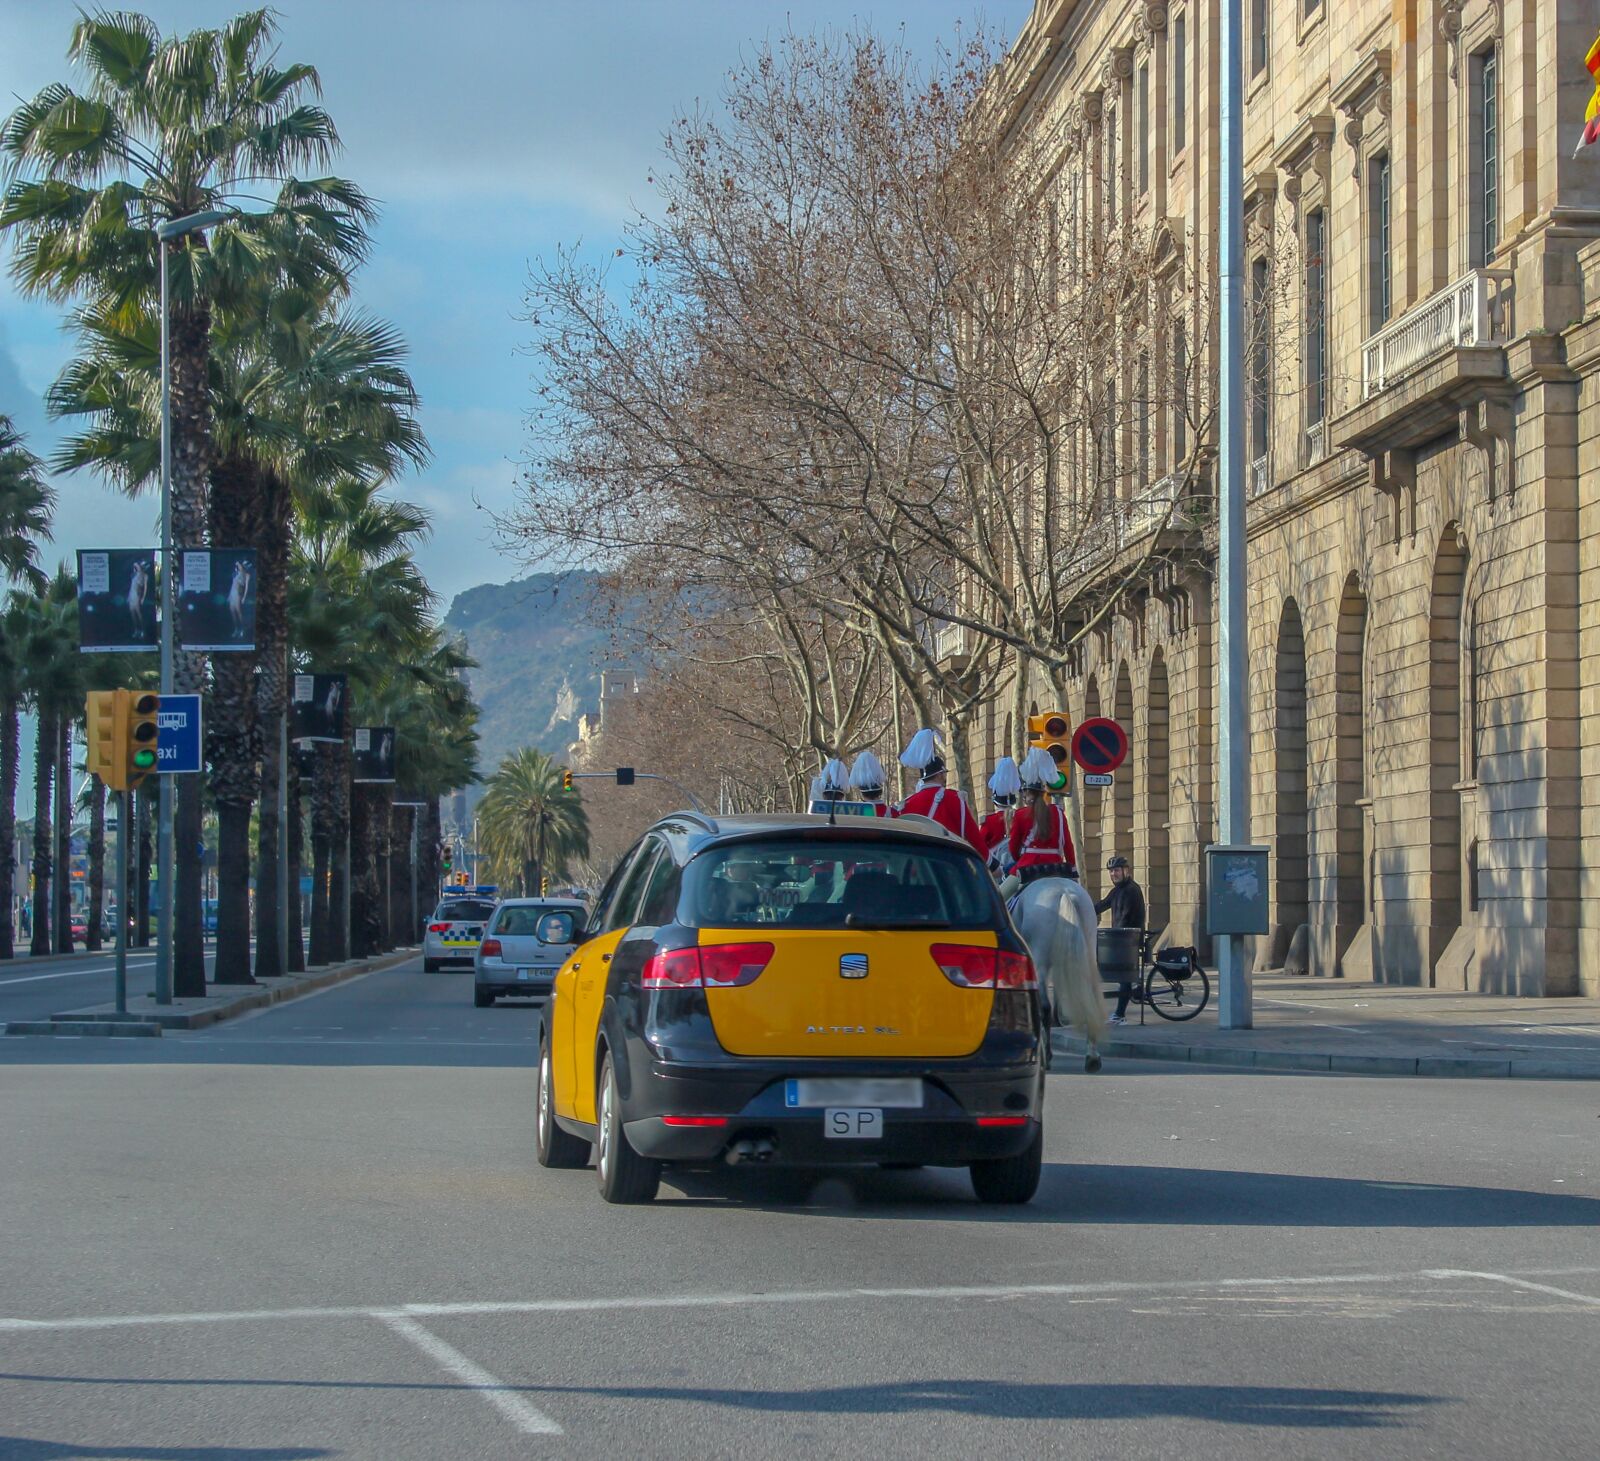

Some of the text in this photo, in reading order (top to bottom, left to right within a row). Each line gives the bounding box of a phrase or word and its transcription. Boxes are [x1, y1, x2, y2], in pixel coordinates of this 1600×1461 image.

[157, 744, 177, 759] axi
[805, 1025, 901, 1035] ALTEA XL
[832, 1111, 875, 1135] SP
